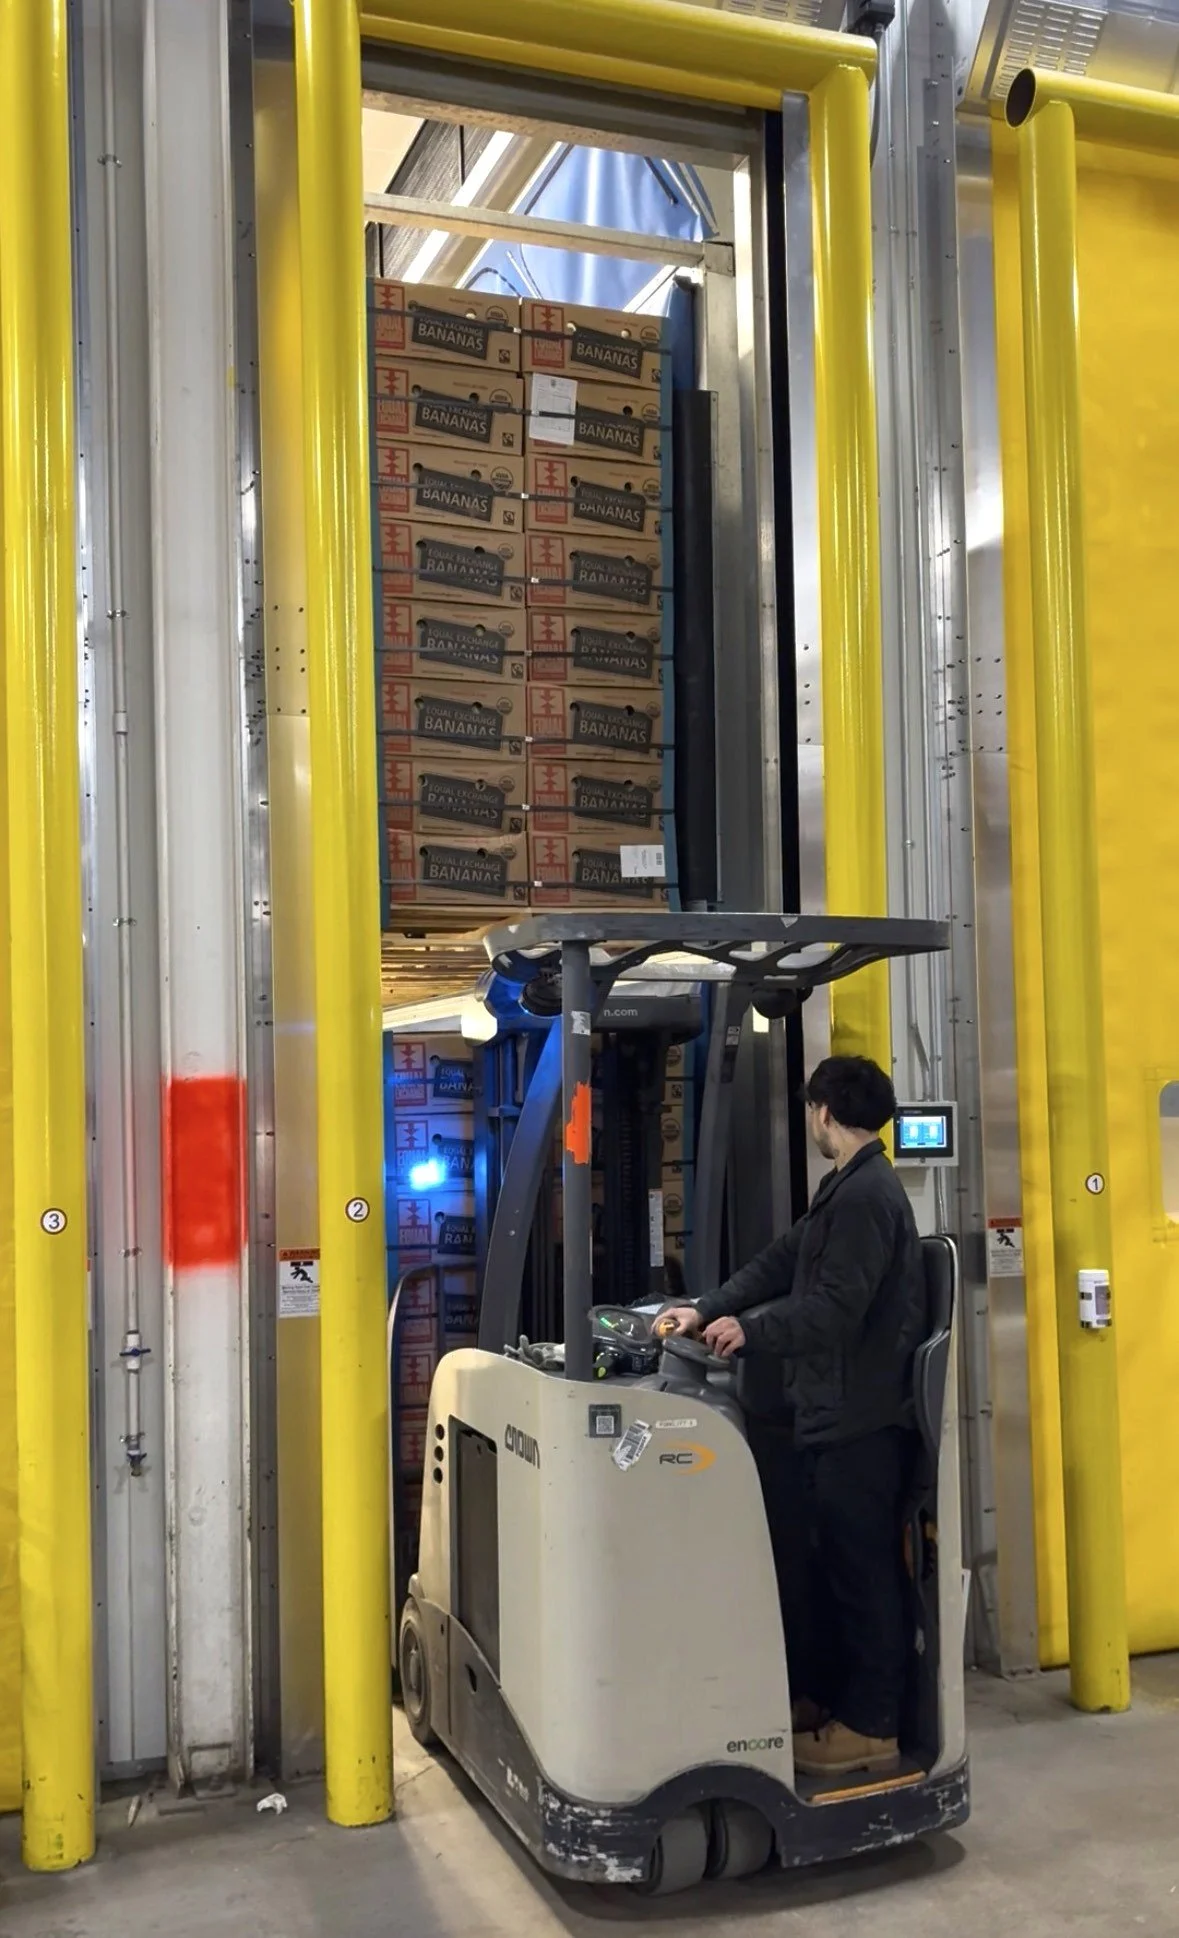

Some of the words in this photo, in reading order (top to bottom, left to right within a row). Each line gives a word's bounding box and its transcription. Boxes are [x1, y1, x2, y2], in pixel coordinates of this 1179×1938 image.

[418, 323, 484, 351] BANANAS
[576, 343, 638, 370] BANANAS
[421, 406, 488, 435] BANANAS
[578, 422, 641, 449] BANANAS
[422, 488, 488, 513] BANANAS
[428, 548, 454, 562] EQUAL
[456, 554, 499, 571] EXCHANGE
[428, 628, 454, 641] EQUAL
[456, 635, 499, 650] EXCHANGE
[424, 715, 497, 737] BANANAS
[426, 706, 451, 718] EQUAL
[453, 711, 497, 727] EXCHANGE
[580, 709, 605, 722] EQUAL
[607, 714, 647, 729] EXCHANGE
[579, 719, 647, 744] BANANAS
[428, 783, 454, 797] EQUAL
[456, 789, 499, 804] EXCHANGE
[429, 863, 501, 882] BANANAS
[431, 854, 457, 866] EQUAL
[459, 859, 501, 872] EXCHANGE
[583, 857, 607, 869] EQUAL
[603, 1008, 638, 1016] n.com
[1092, 1178, 1098, 1190] 1
[353, 1202, 364, 1218] 2
[48, 1213, 60, 1229] 3
[504, 1423, 541, 1469] CROWN
[659, 1453, 692, 1464] RC
[727, 1736, 784, 1753] encore
